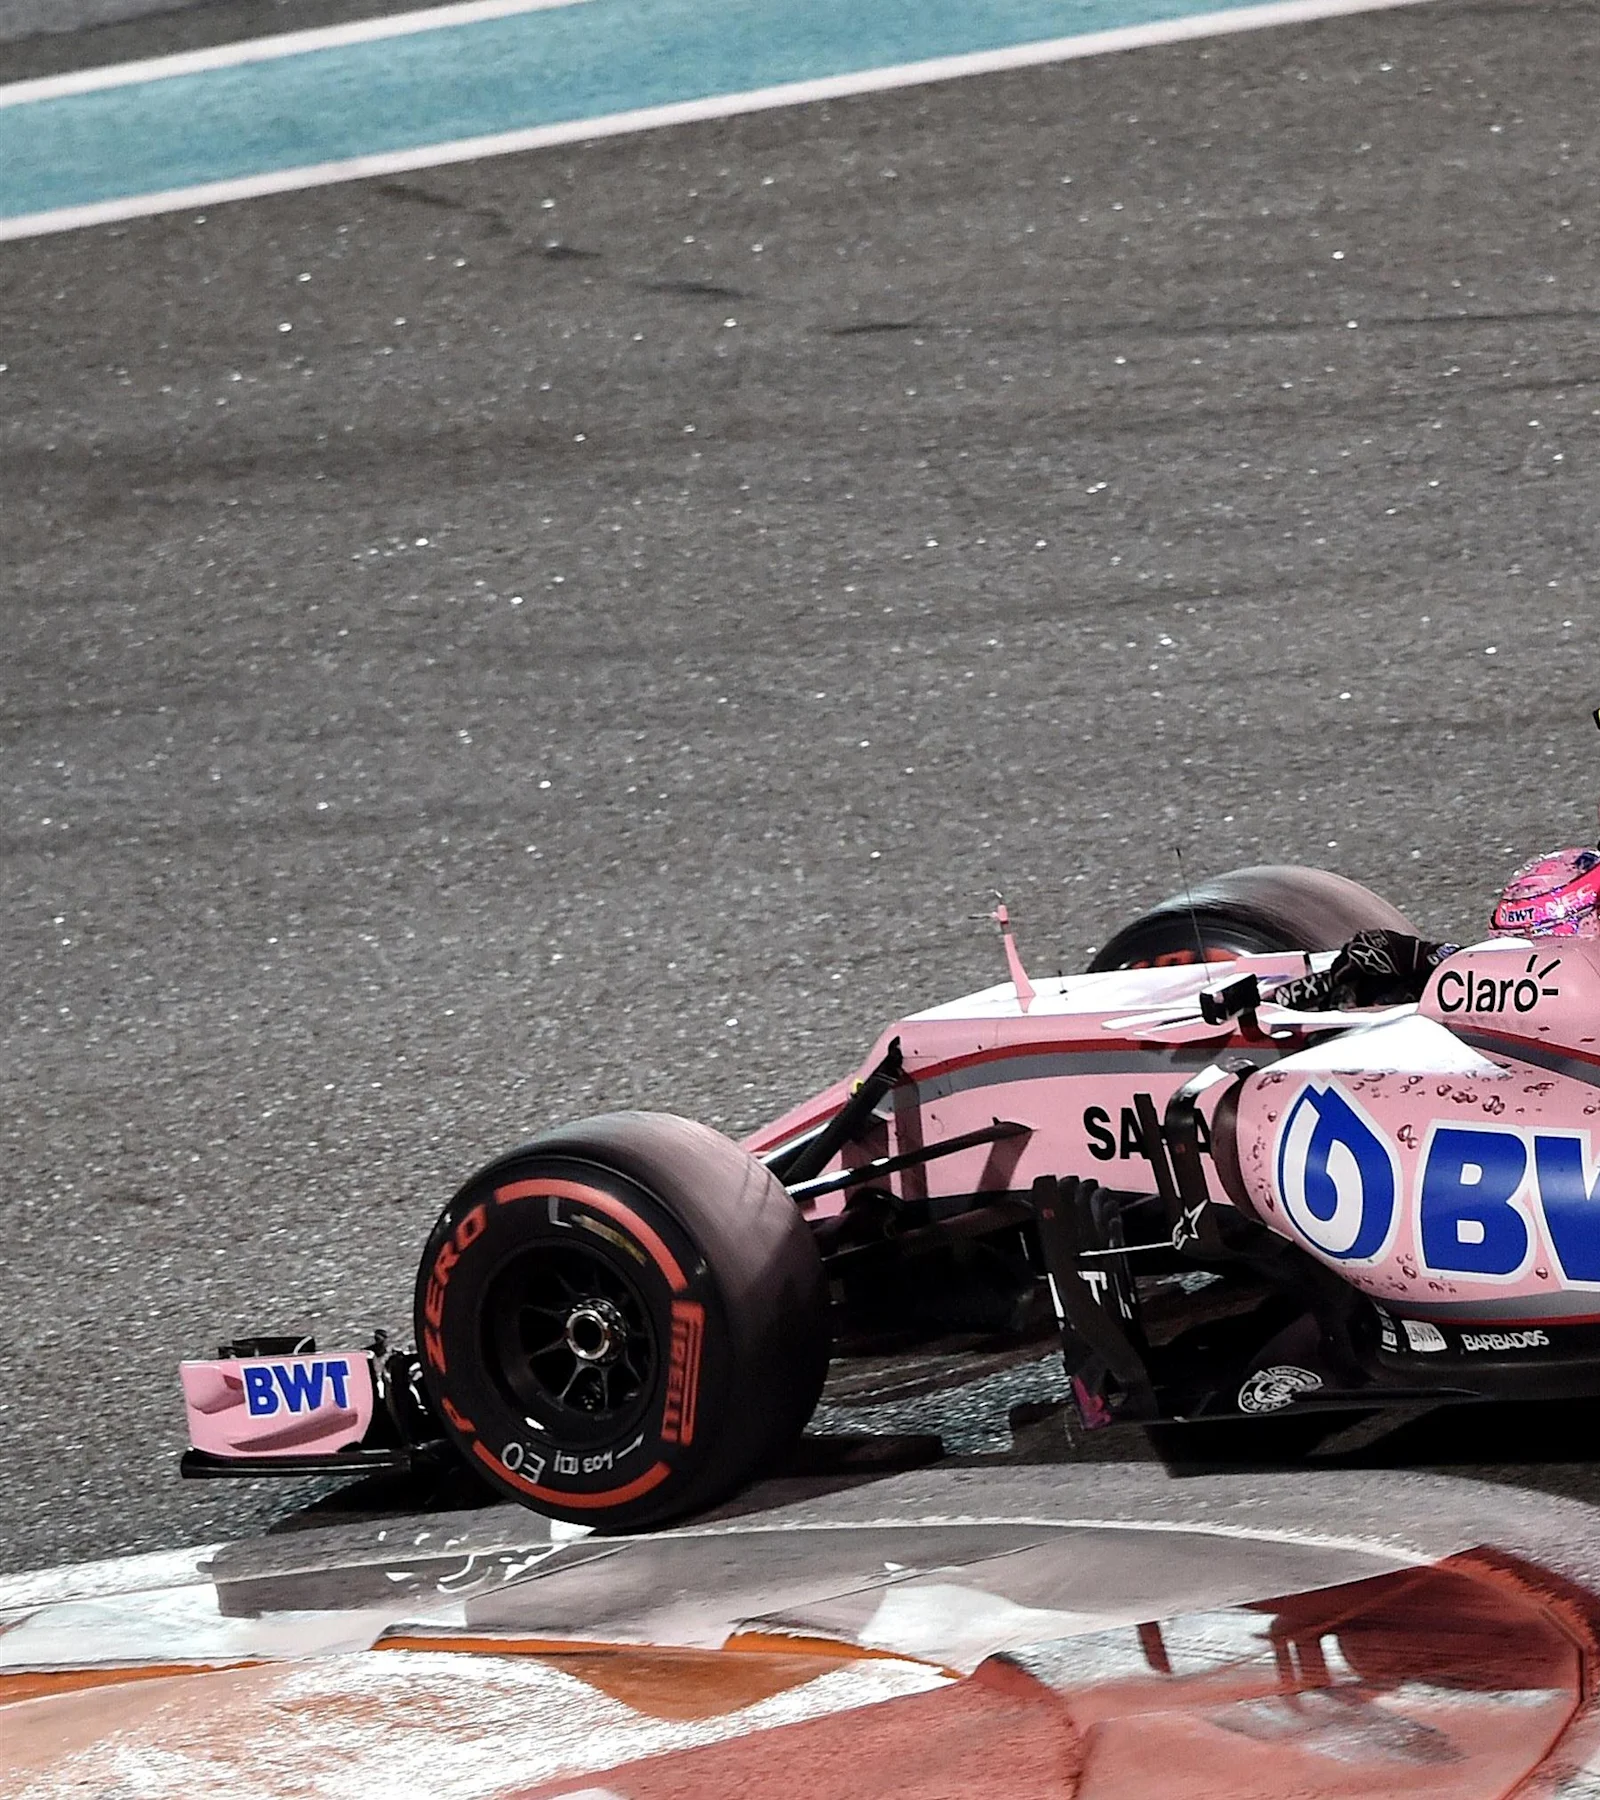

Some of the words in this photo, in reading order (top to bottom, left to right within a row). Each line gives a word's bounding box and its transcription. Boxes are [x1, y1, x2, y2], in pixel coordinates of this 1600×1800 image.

[1509, 906, 1535, 923] BWT
[424, 1202, 488, 1375] ZERO
[1460, 1329, 1551, 1352] BARBADOS
[242, 1359, 350, 1417] BWT
